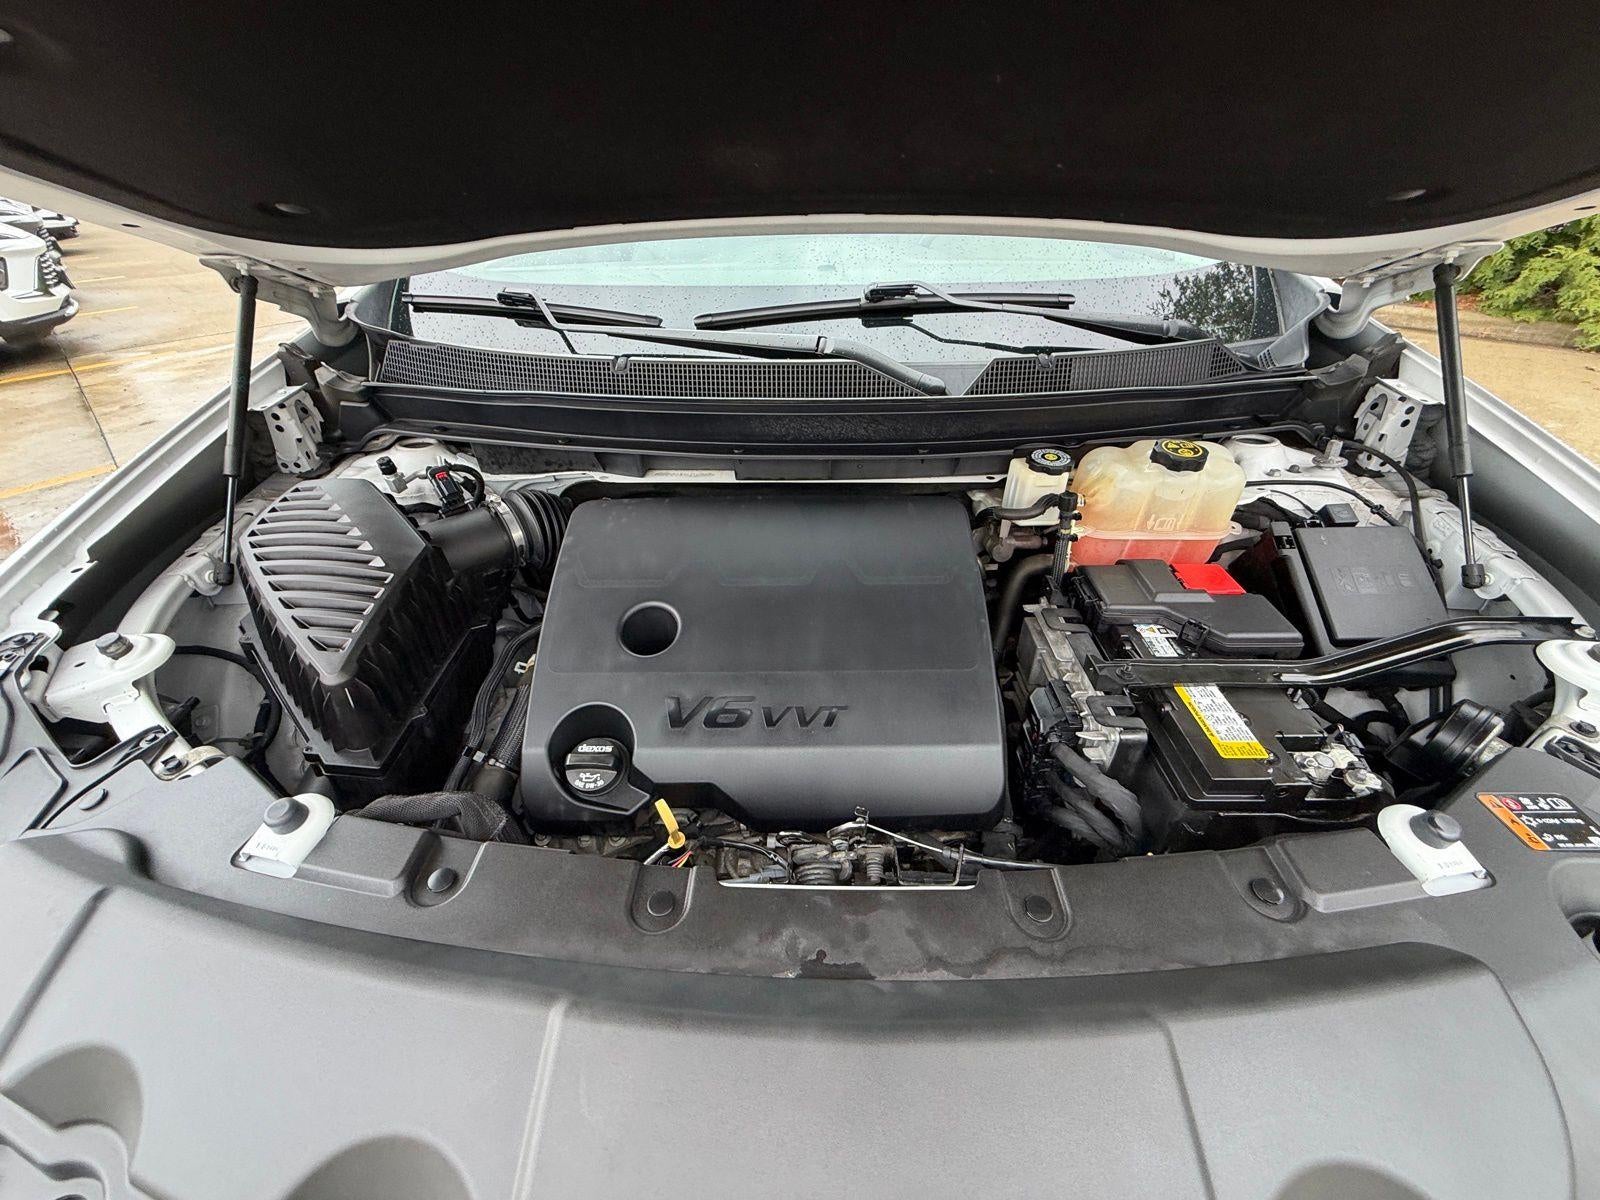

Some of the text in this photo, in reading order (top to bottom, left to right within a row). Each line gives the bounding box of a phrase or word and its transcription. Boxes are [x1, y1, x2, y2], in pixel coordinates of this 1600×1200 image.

[665, 695, 849, 729] V6 VVT
[577, 743, 614, 753] dexos
